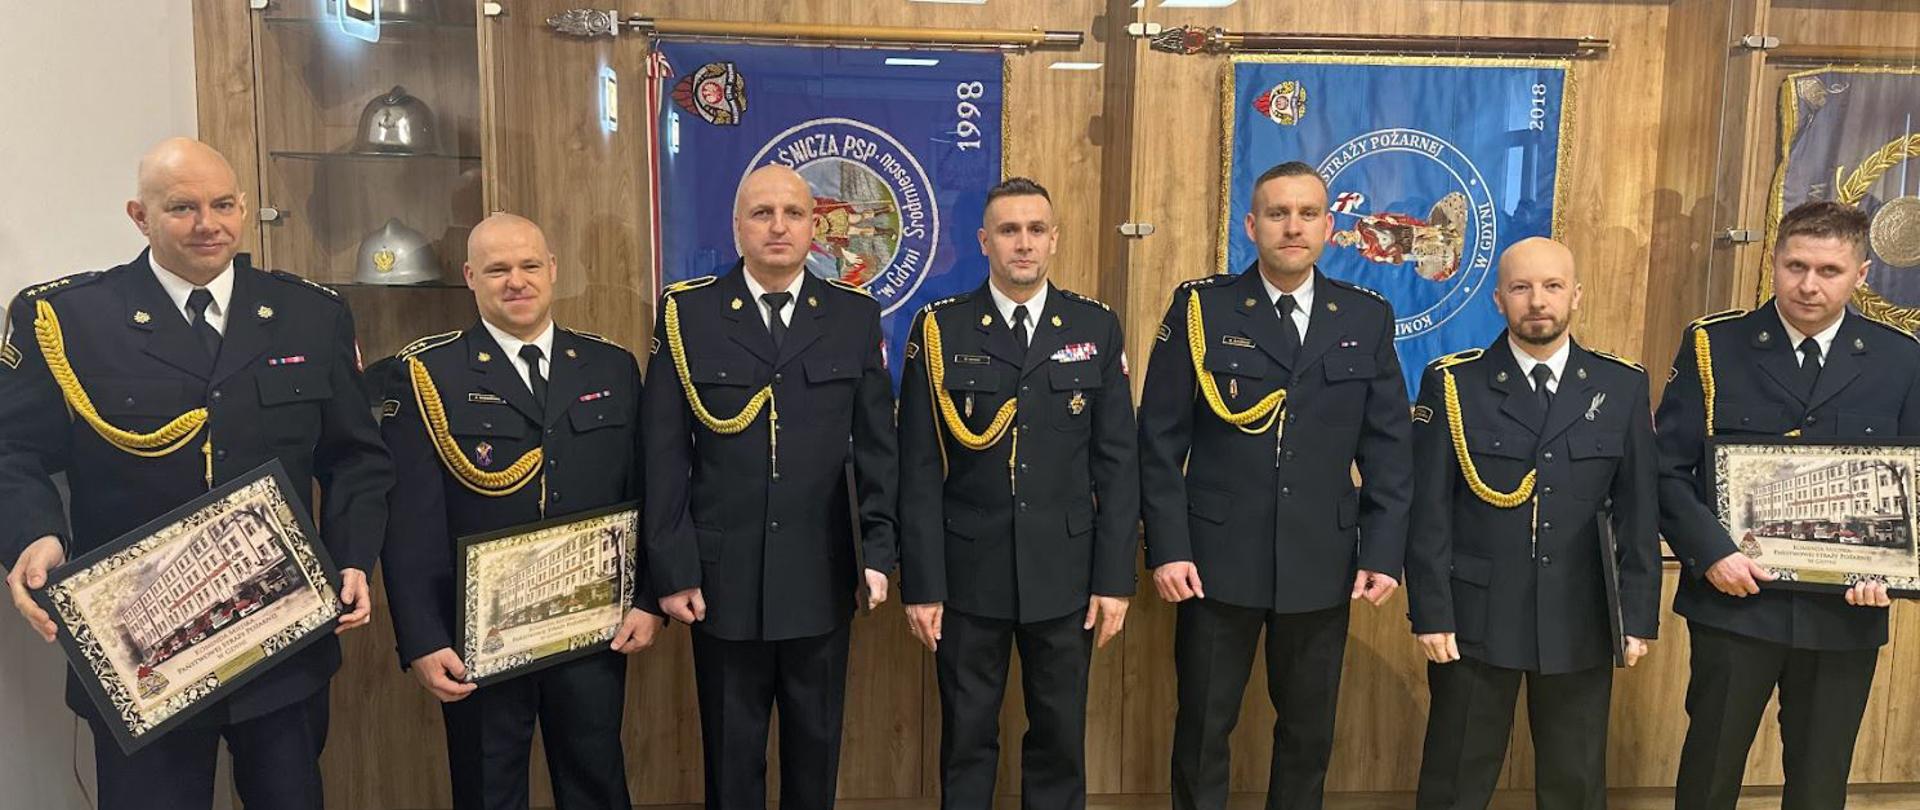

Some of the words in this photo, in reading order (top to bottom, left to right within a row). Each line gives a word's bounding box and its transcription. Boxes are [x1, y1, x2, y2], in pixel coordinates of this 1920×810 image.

[956, 80, 984, 151] 1998
[1529, 83, 1547, 131] 2018
[771, 133, 840, 169] ŚNICZA
[842, 134, 877, 162] PSP
[1320, 141, 1367, 182] STRAŻY
[1370, 131, 1445, 158] POŻARNEJ
[1478, 202, 1493, 251] GDYNI
[886, 247, 921, 288] Gdyni
[1474, 253, 1489, 269] W
